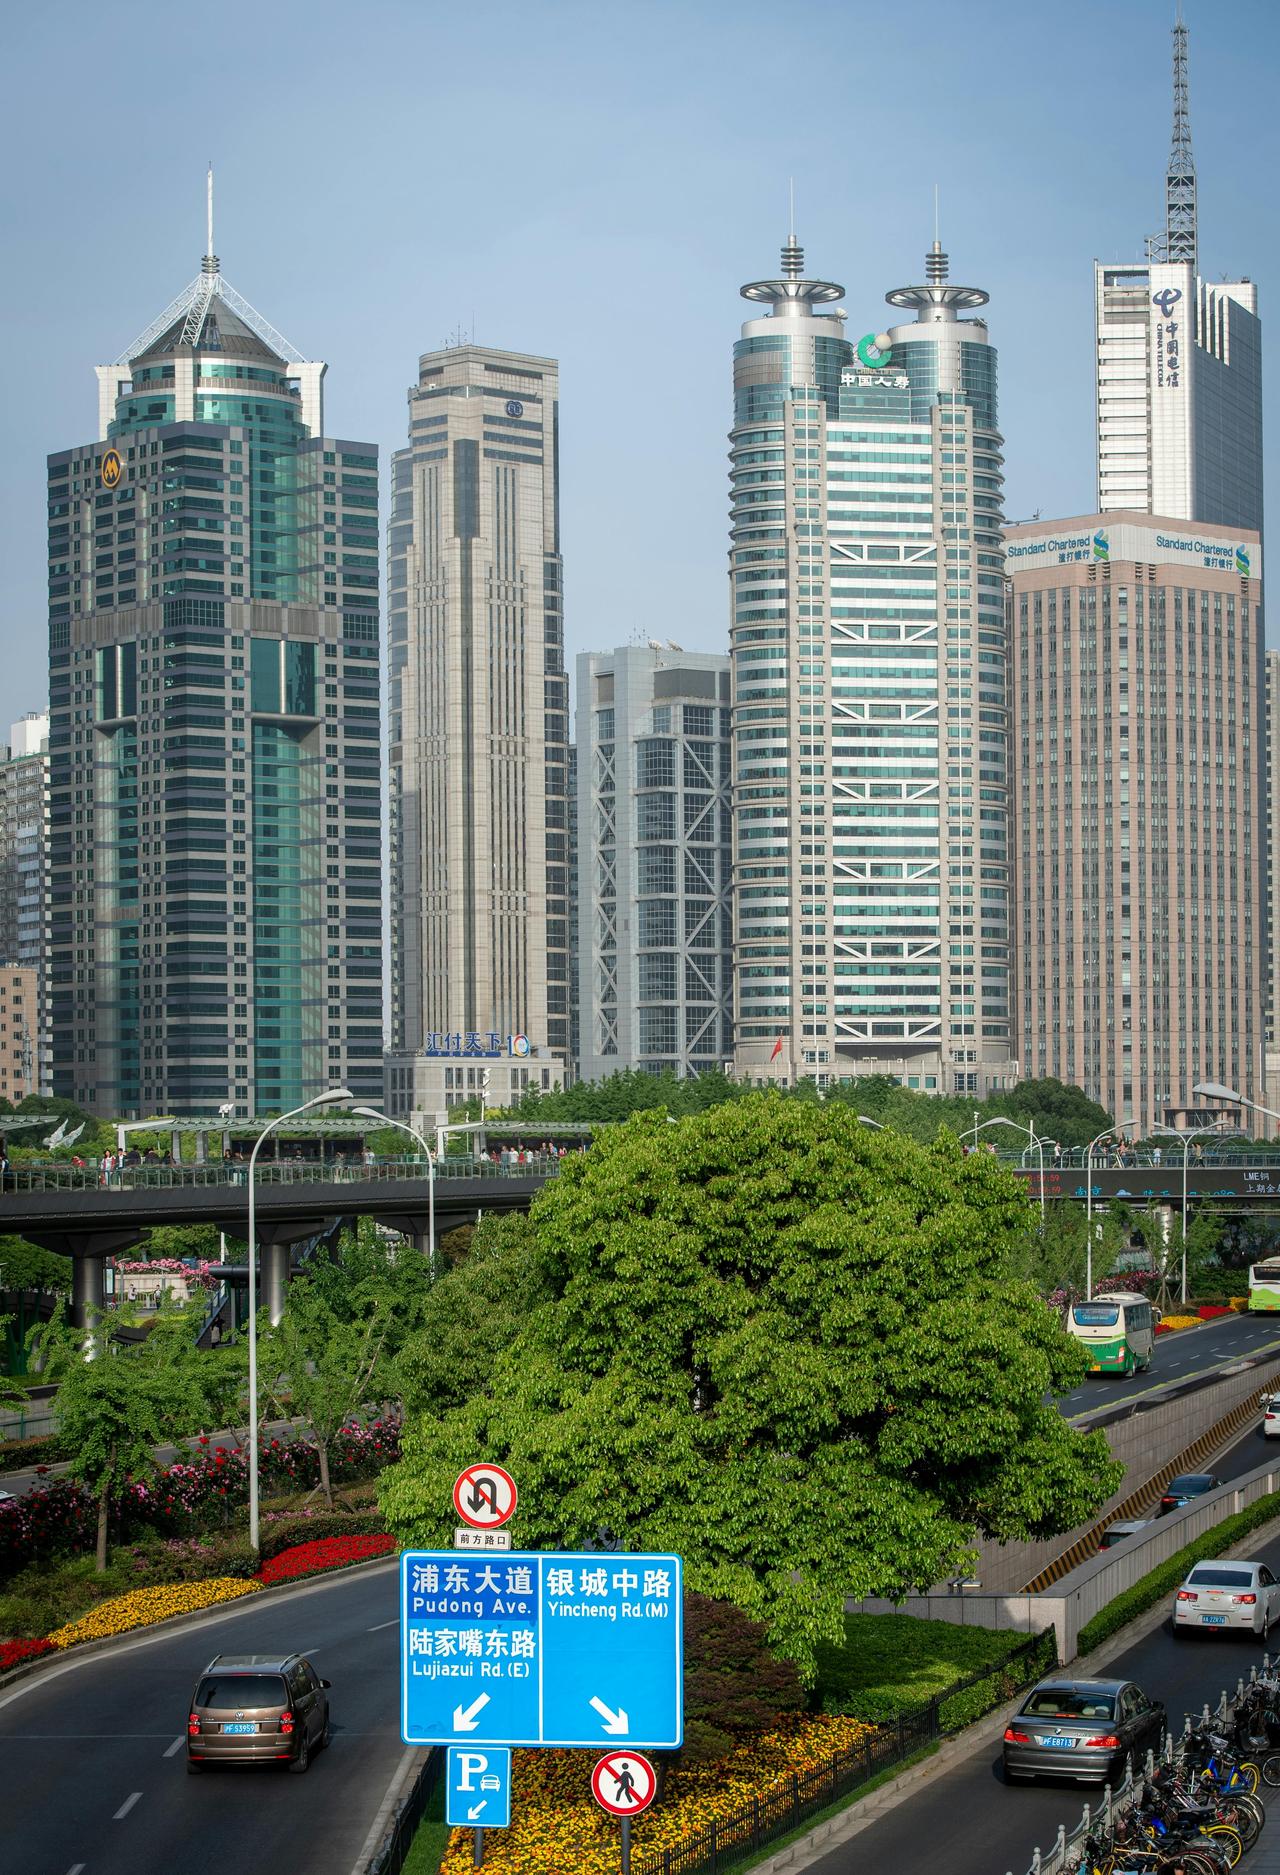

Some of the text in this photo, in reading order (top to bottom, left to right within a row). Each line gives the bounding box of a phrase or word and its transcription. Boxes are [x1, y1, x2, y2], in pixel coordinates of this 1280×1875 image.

[1166, 321, 1180, 388] 中国电信
[841, 373, 910, 389] 中国人寿
[1008, 536, 1090, 557] Standard Chartered
[1156, 536, 1233, 557] Standard Chartered
[427, 1032, 501, 1051] 汇付天下
[460, 1533, 506, 1545] 前方路口
[412, 1564, 534, 1594] 浦东大道
[546, 1567, 671, 1598] 银城中路
[413, 1597, 531, 1618] Pudong Ave.
[548, 1601, 617, 1621] Yincheng
[409, 1627, 536, 1658] 陆家嘴东路
[412, 1660, 473, 1680] Lujiazui
[456, 1753, 488, 1792] P
